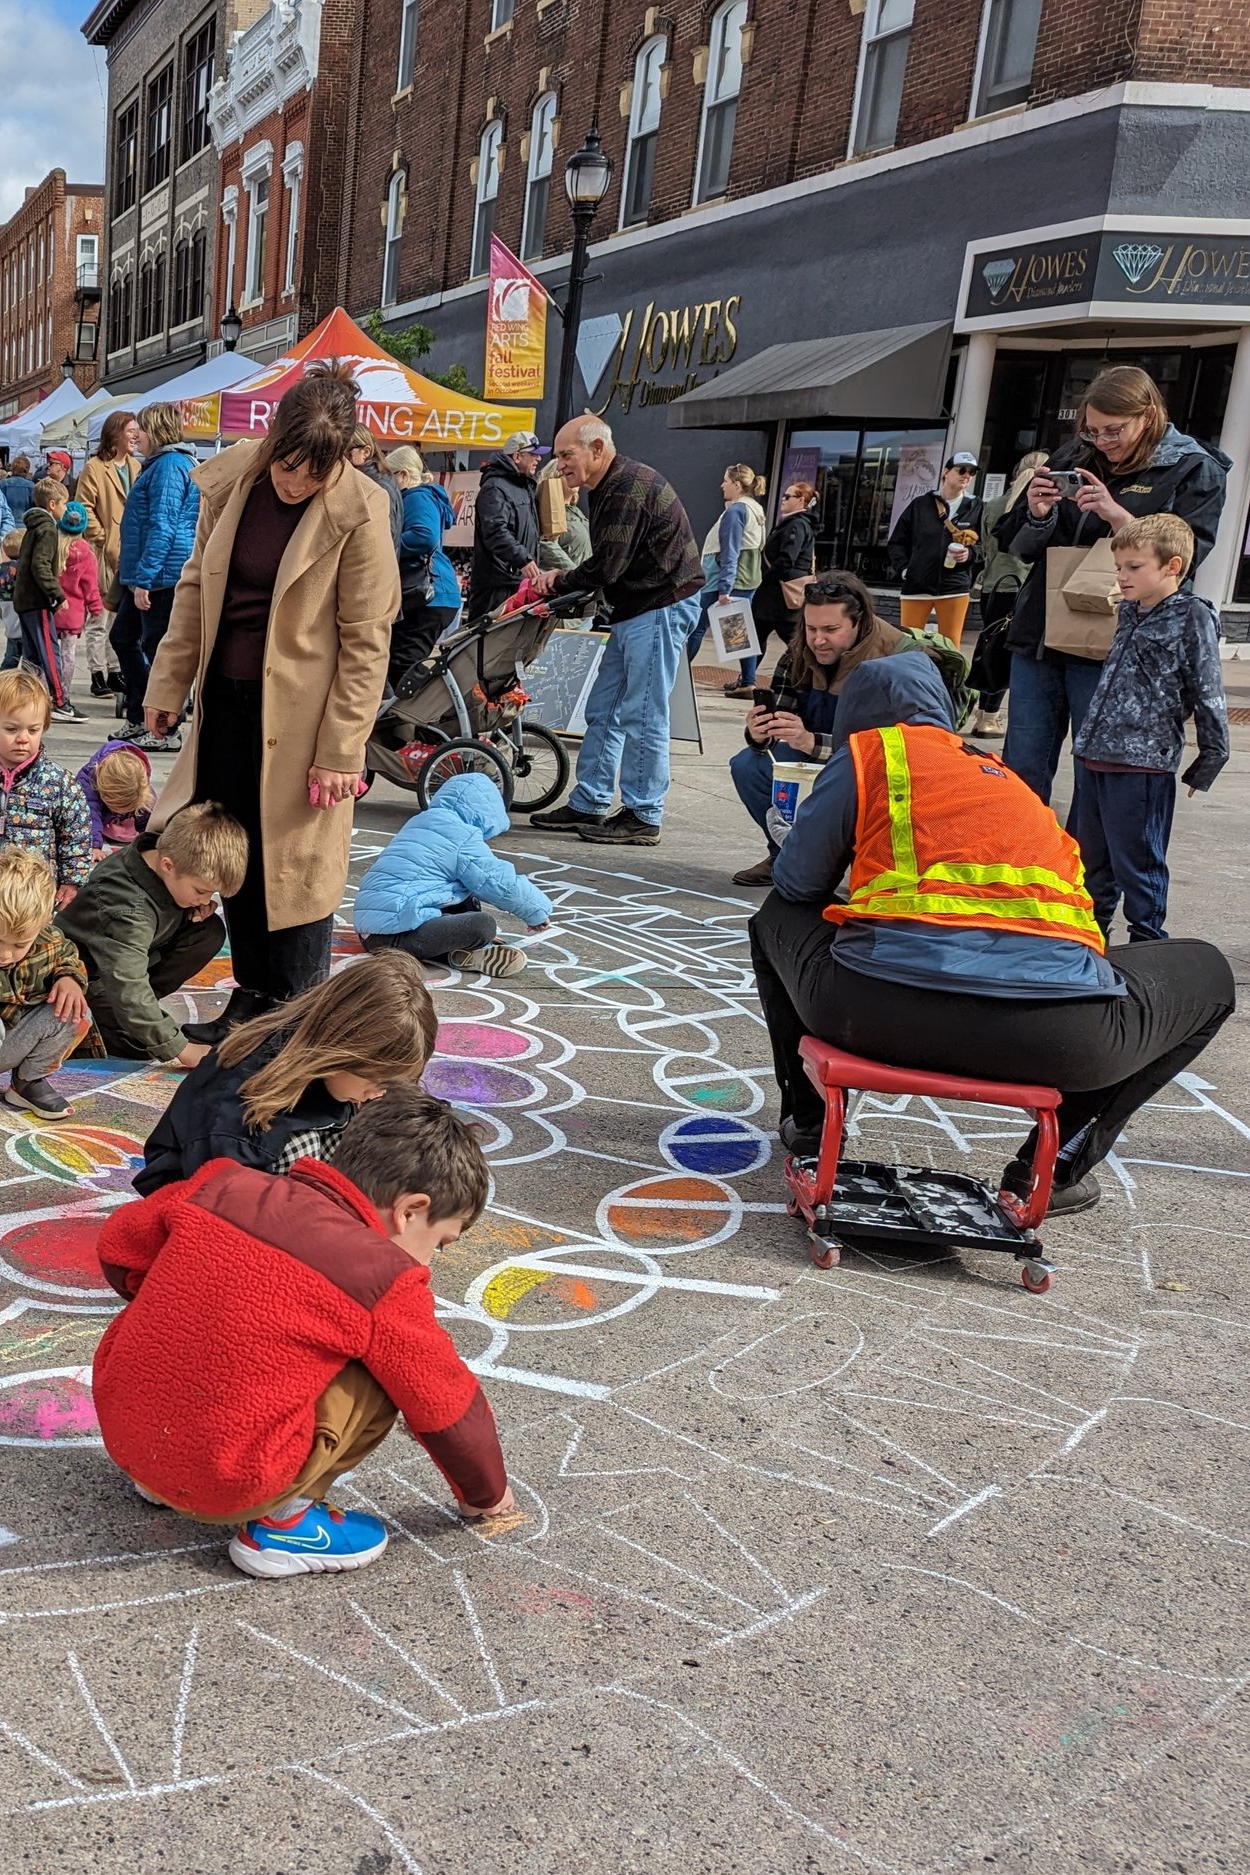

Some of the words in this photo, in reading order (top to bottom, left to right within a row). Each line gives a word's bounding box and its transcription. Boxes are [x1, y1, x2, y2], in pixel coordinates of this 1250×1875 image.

[1125, 244, 1250, 295] HOWE
[1224, 281, 1250, 296] Jewel
[492, 323, 506, 332] RED
[508, 323, 529, 332] WING
[490, 333, 529, 347] ARTS
[490, 350, 513, 364] fall
[488, 364, 541, 378] festival
[510, 380, 540, 388] weekend
[1059, 409, 1076, 419] 301
[355, 404, 414, 436] ING
[419, 408, 503, 441] ARTS
